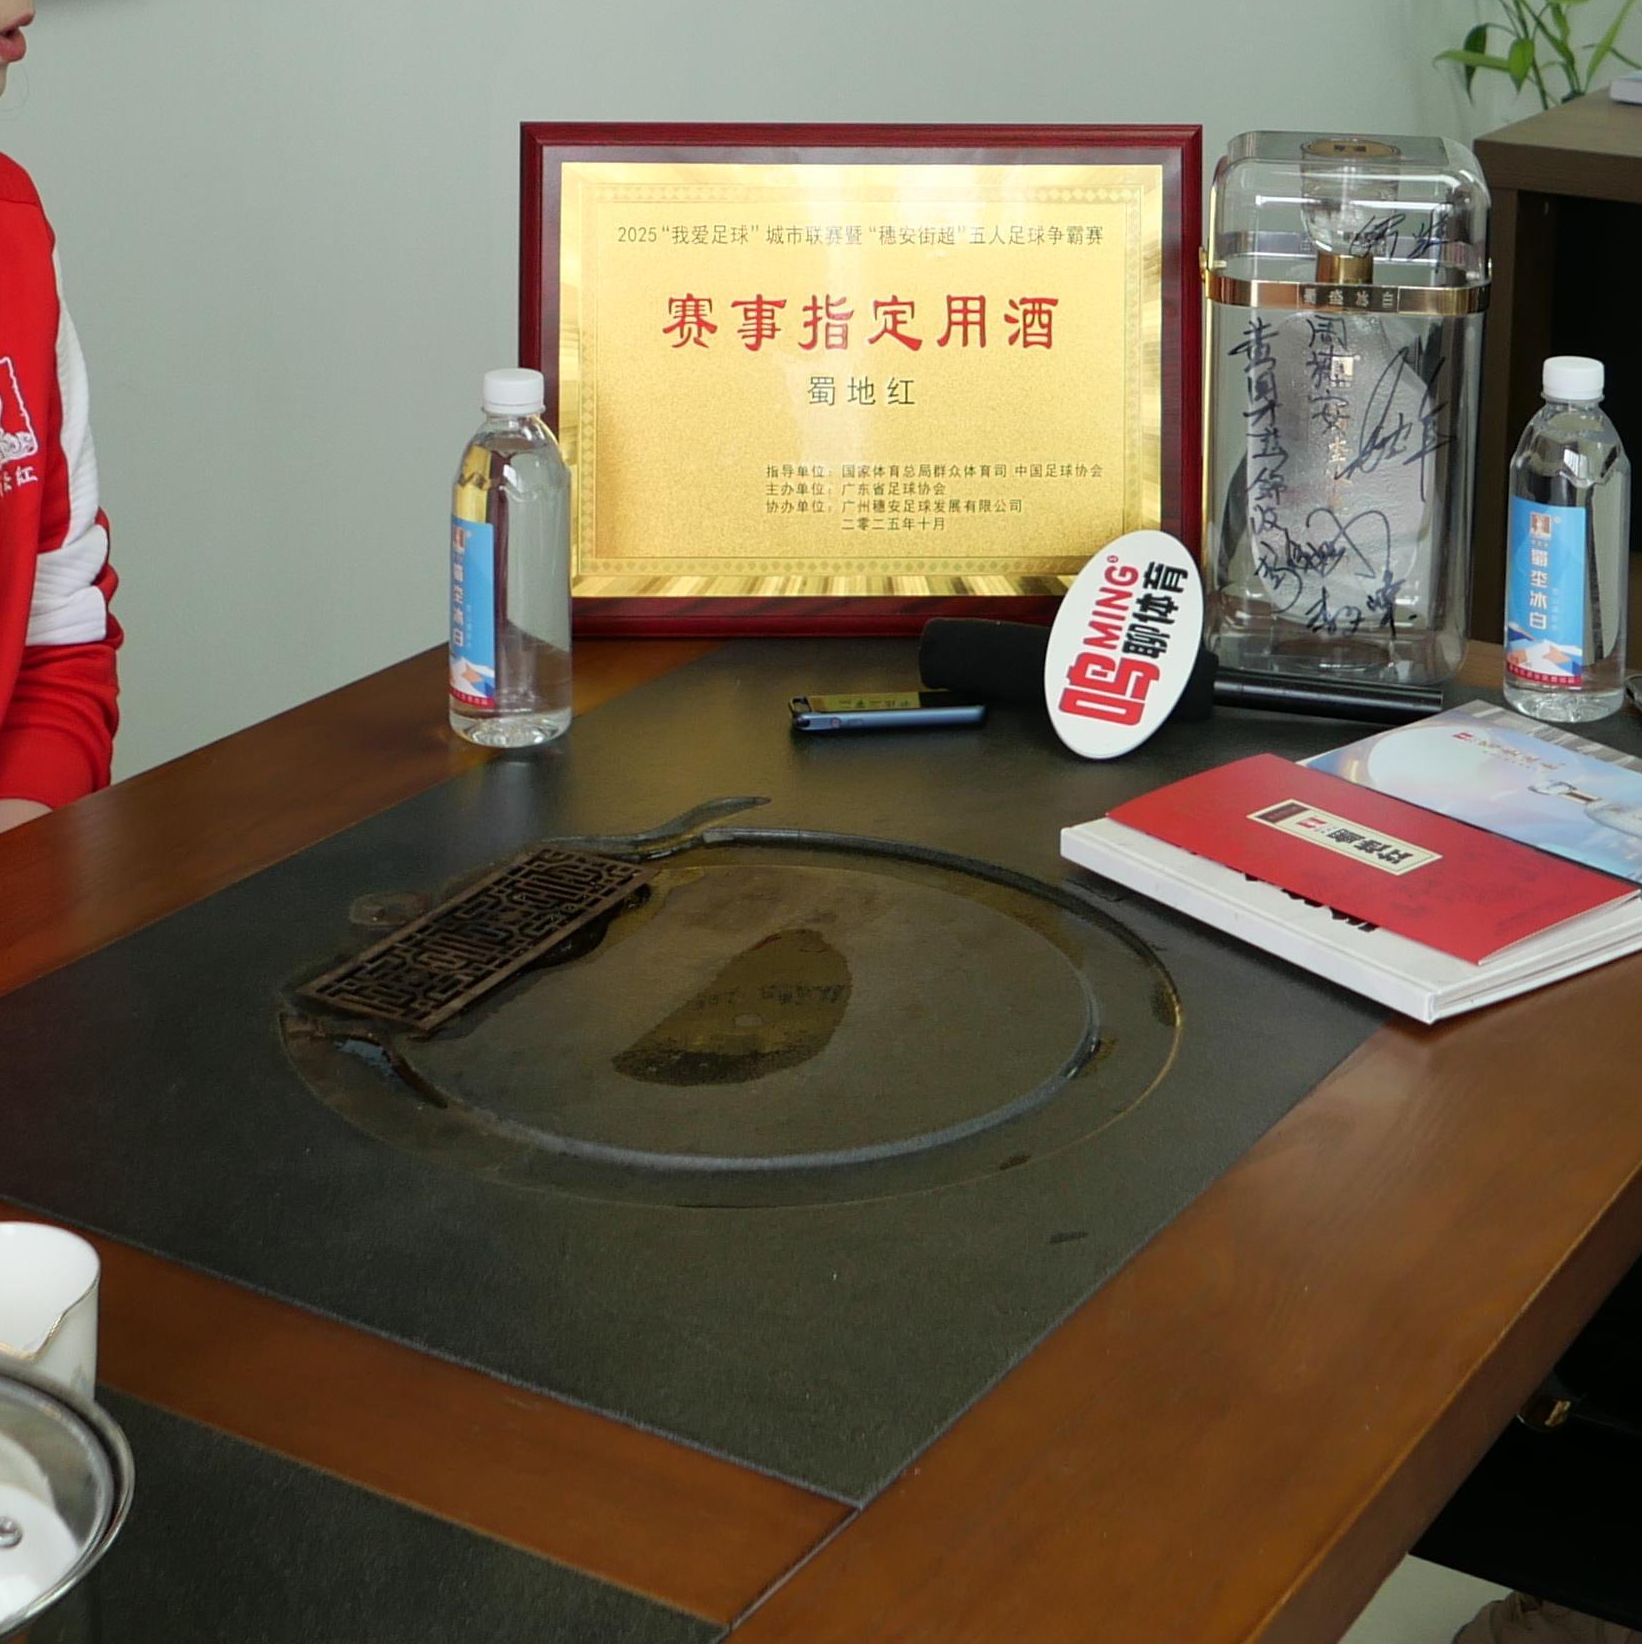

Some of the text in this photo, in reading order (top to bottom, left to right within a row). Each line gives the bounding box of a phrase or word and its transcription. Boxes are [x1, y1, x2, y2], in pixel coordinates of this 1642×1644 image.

[662, 293, 1059, 352] 赛事指定用酒
[807, 375, 916, 408] 蜀地红
[842, 516, 946, 532] 二零二五年十月
[1083, 564, 1140, 651] MING
[1121, 560, 1189, 659] 聊体育
